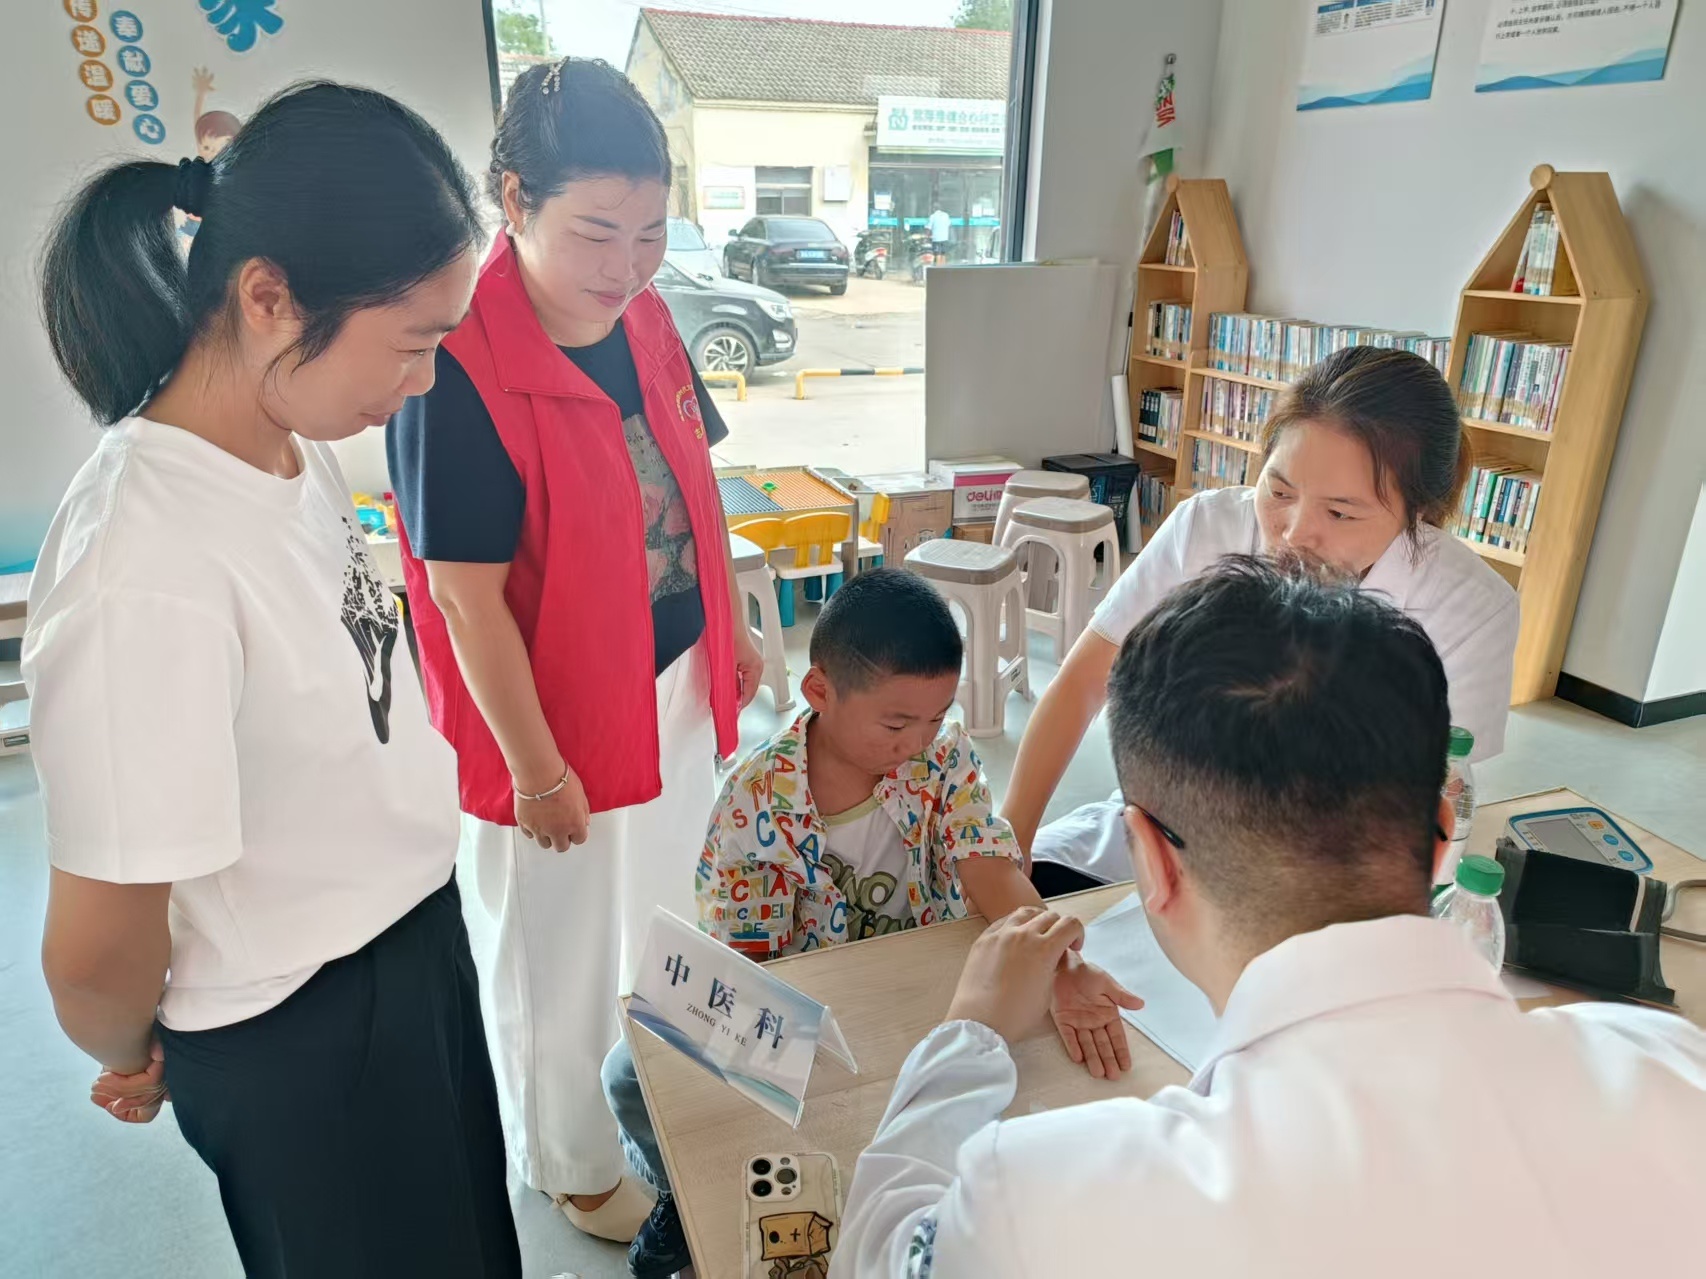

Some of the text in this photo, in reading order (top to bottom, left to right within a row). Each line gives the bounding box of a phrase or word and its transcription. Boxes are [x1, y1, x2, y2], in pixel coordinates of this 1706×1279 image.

[113, 14, 160, 140] 奉献爱心
[966, 488, 992, 502] deli
[664, 953, 784, 1049] 中医科
[686, 1003, 748, 1047] ZHONG YI KE
